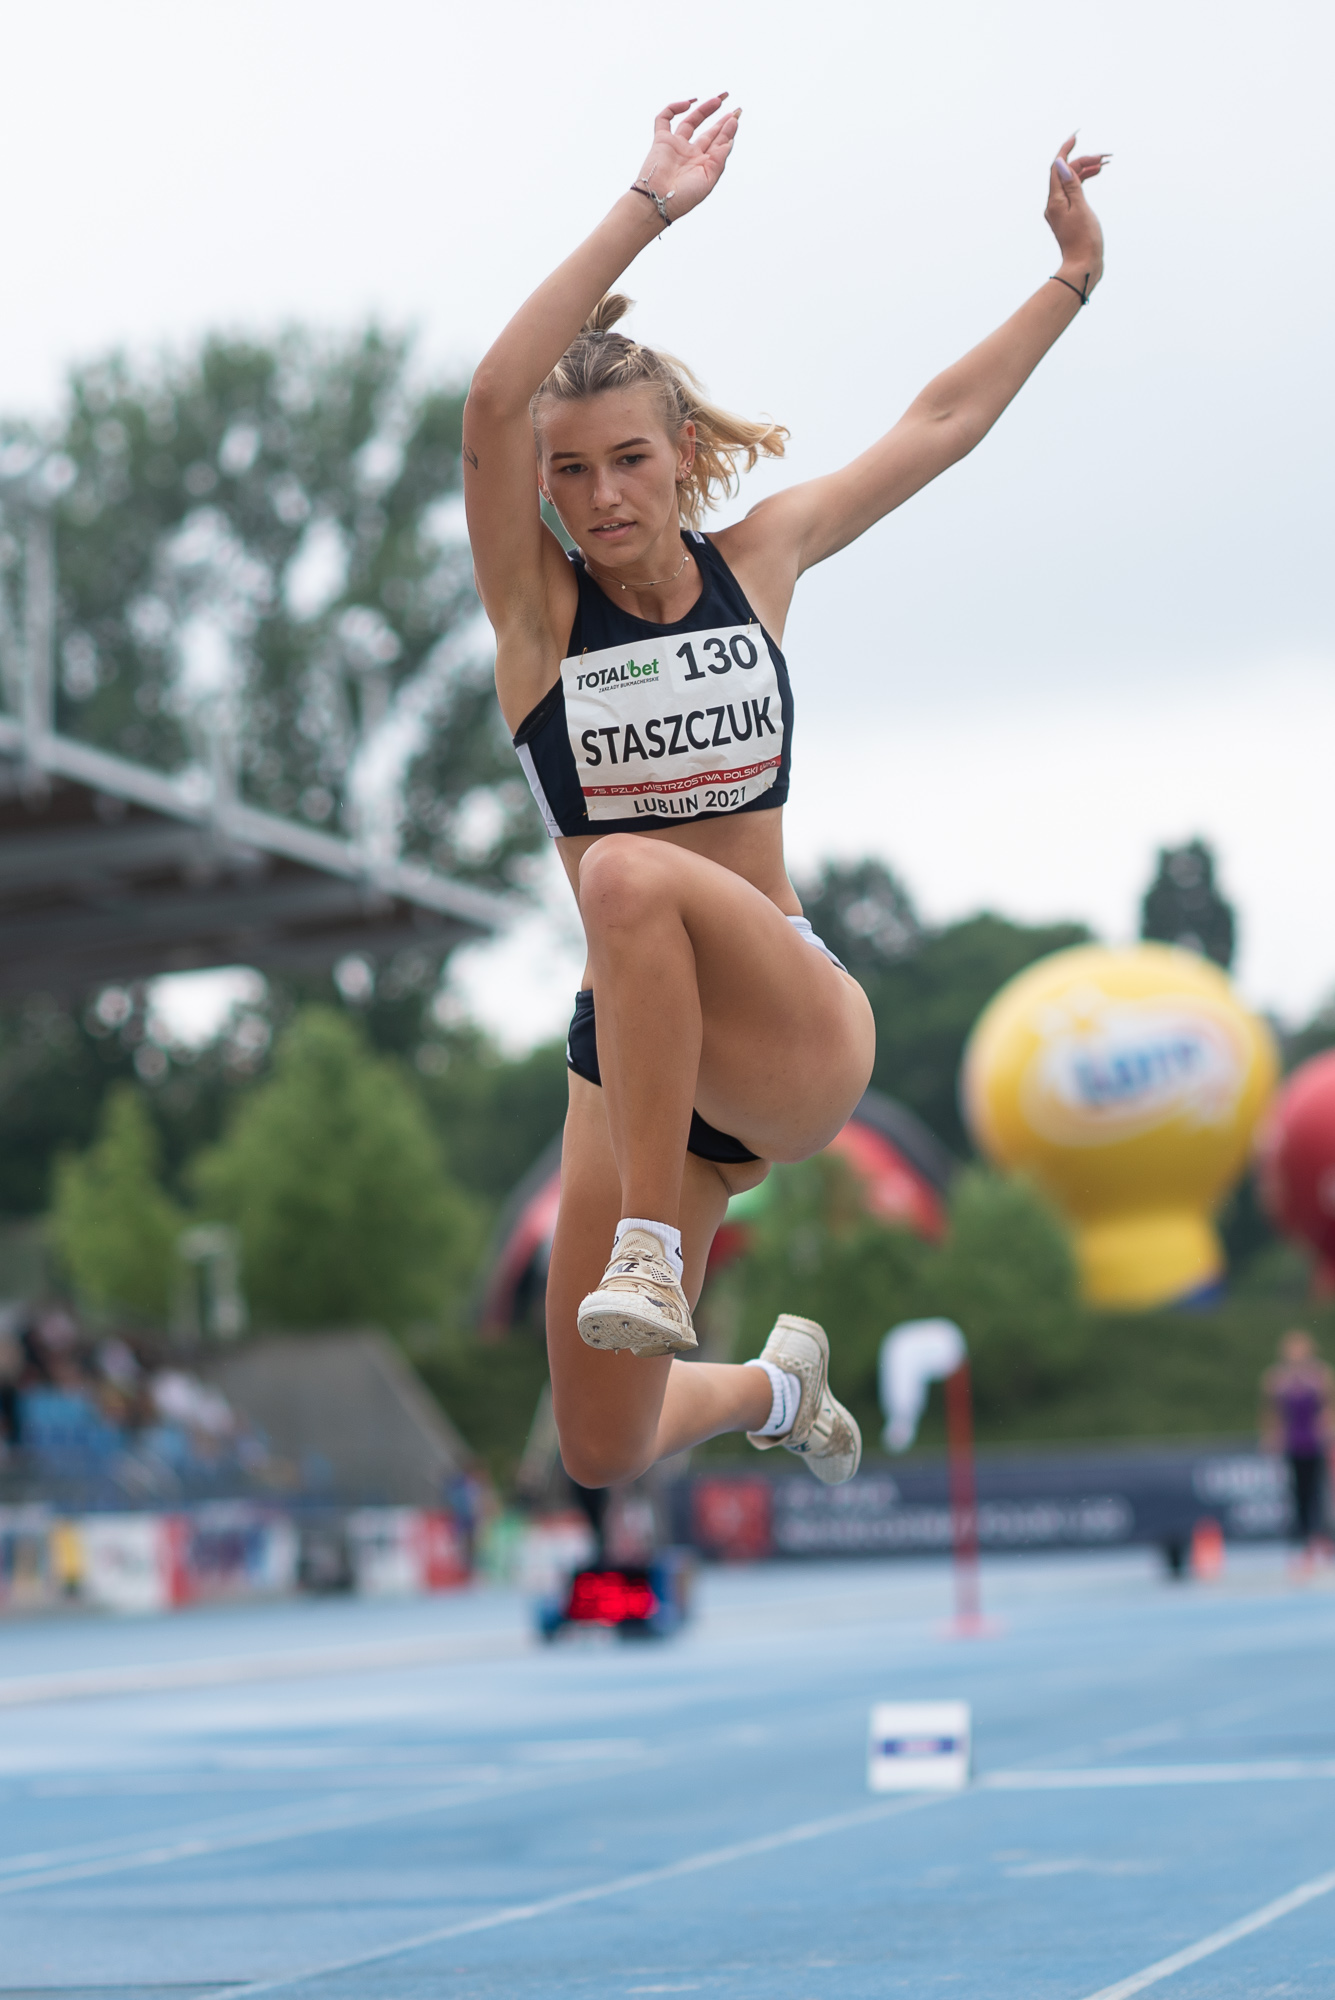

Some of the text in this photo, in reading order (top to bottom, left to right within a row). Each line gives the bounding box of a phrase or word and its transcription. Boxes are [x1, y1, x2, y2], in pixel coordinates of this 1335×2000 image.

[675, 634, 758, 681] 130
[576, 658, 660, 691] TOTALbet
[581, 696, 777, 767] STASZCZUK
[611, 786, 640, 794] PZLA
[643, 773, 721, 792] MISTRZOSTWA
[723, 766, 759, 781] POLSKI
[633, 786, 746, 814] LUBLIN 2021
